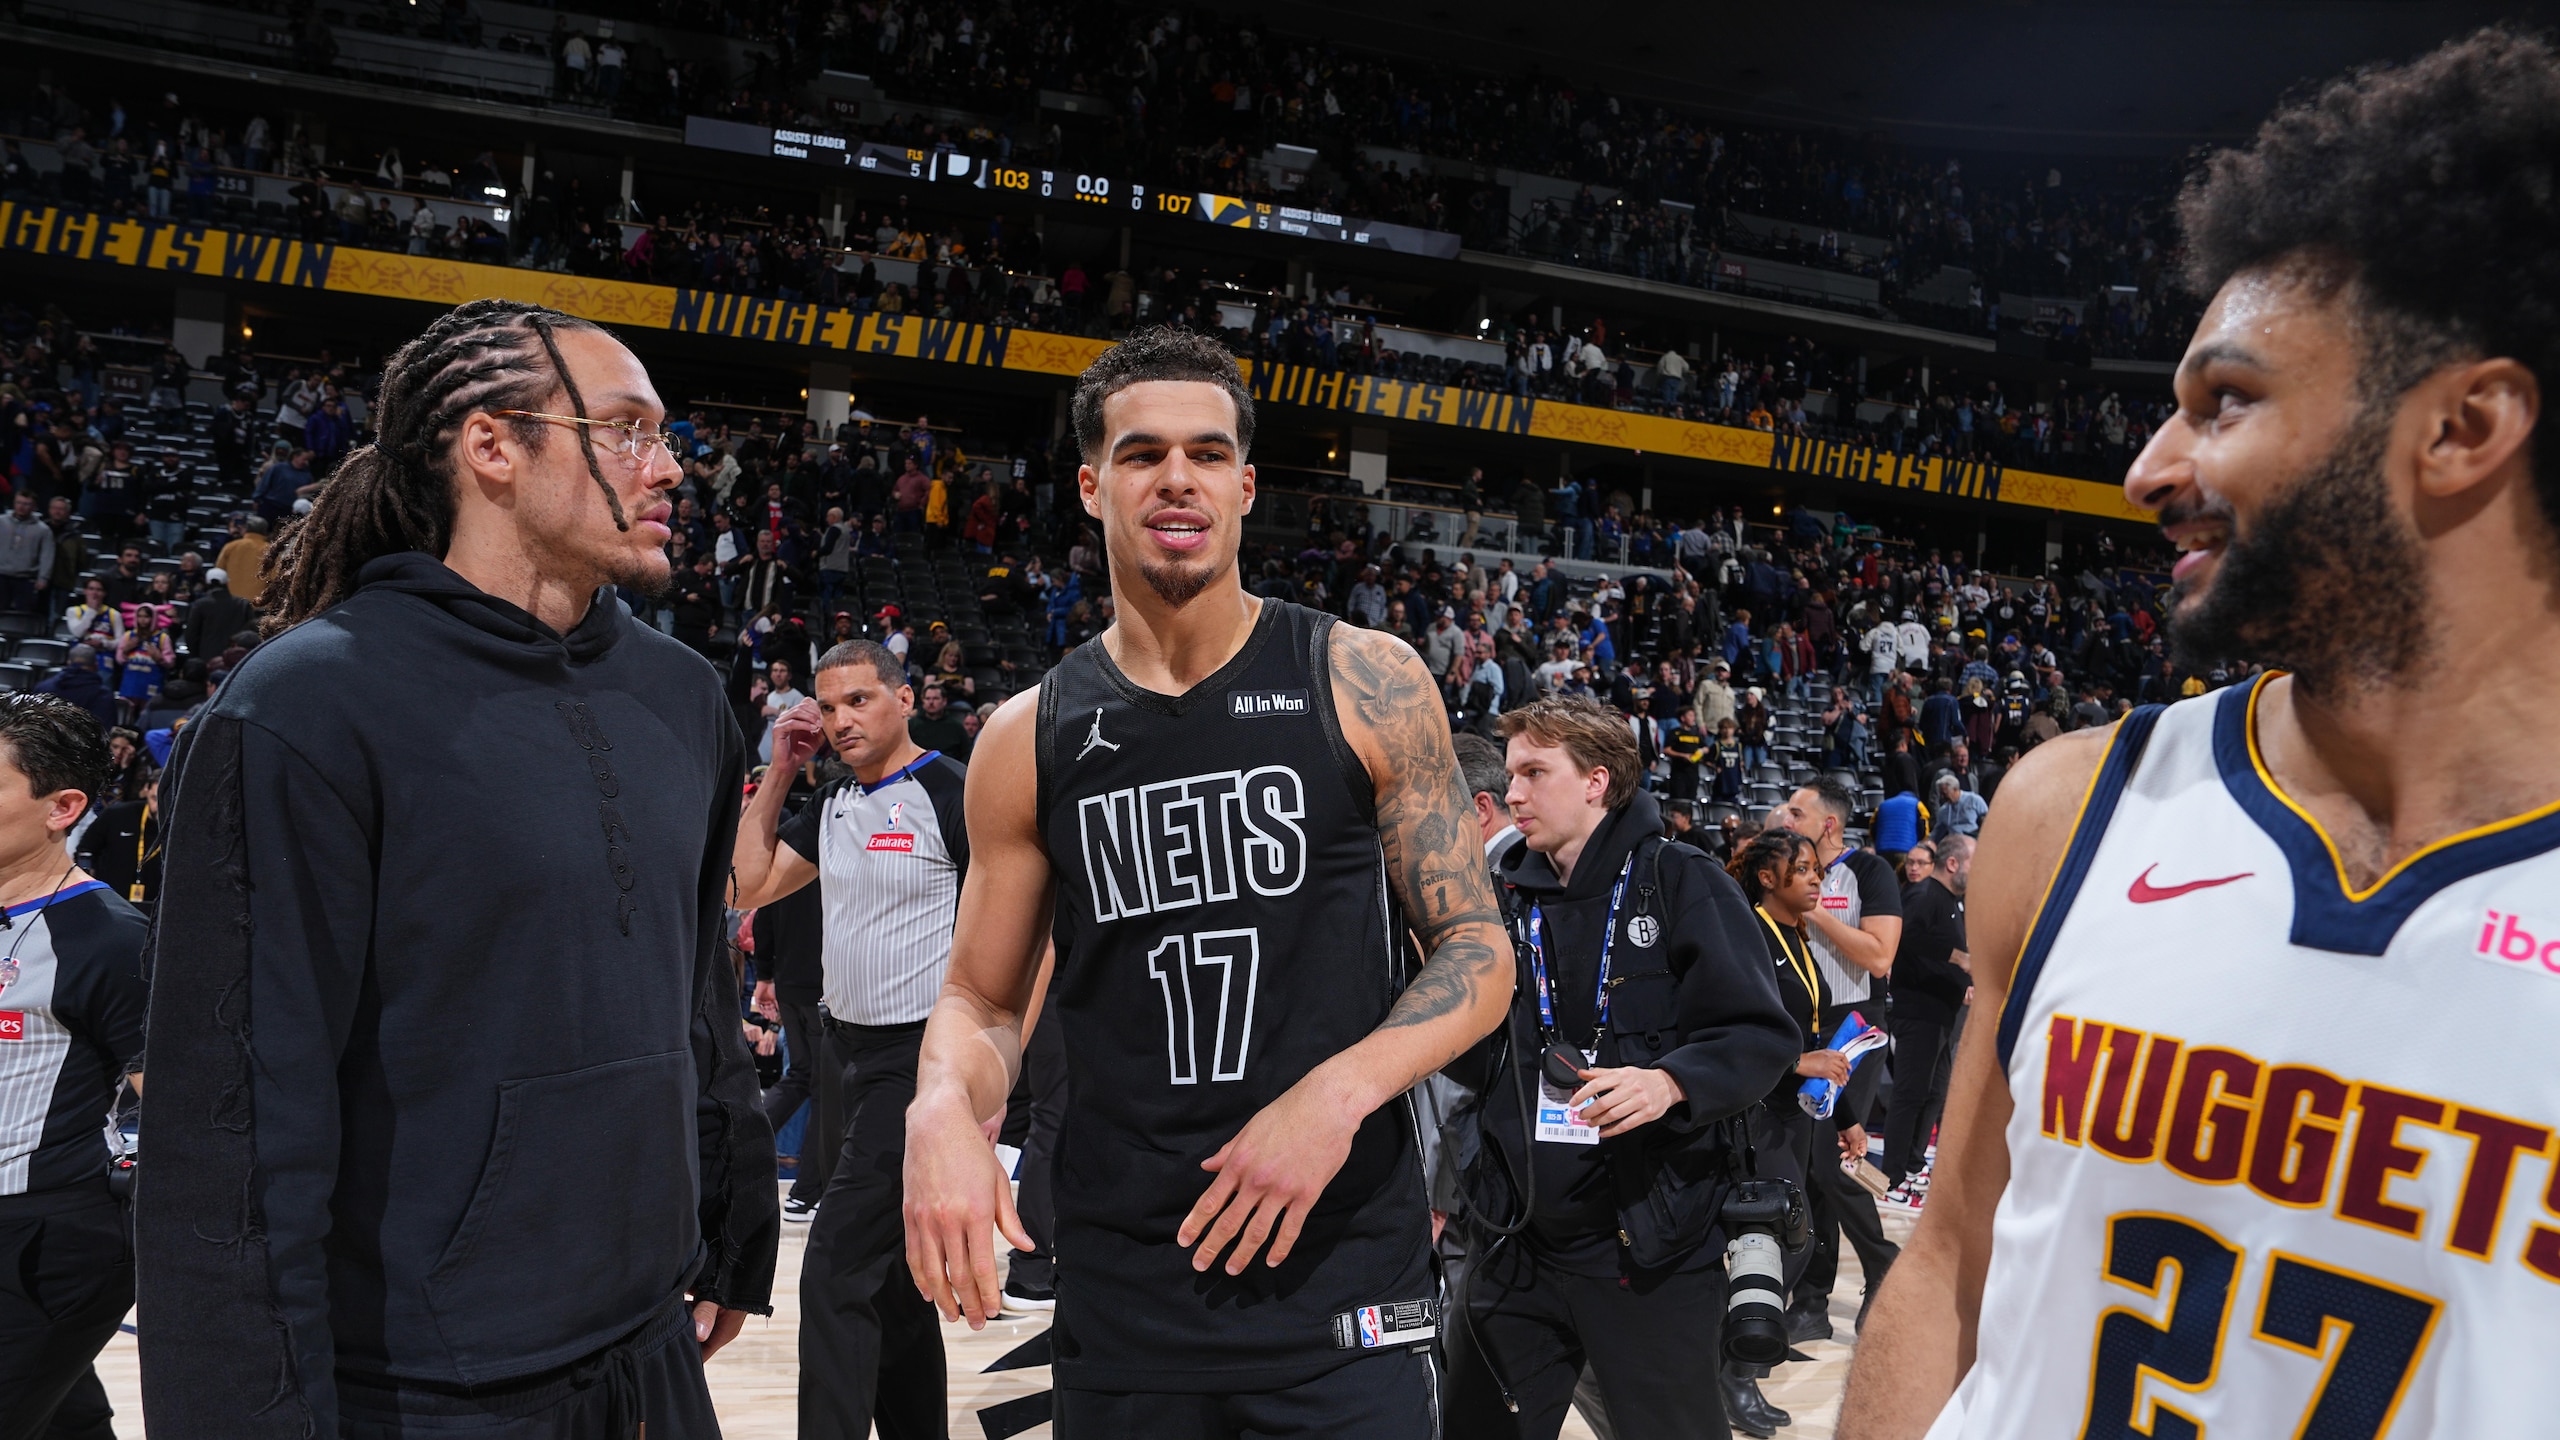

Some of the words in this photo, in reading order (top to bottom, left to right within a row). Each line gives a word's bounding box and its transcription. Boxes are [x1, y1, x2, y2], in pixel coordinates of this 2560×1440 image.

[774, 129, 811, 145] ASSISTS
[812, 136, 847, 150] LEADER
[844, 154, 851, 165] 7
[859, 157, 878, 169] AST
[906, 149, 924, 161] FLS
[910, 163, 921, 177] 5
[993, 168, 1030, 190] 103
[216, 176, 248, 193] 258
[1041, 182, 1053, 197] 0
[1076, 174, 1110, 196] 0.0
[1131, 196, 1143, 211] 0
[1157, 193, 1193, 215] 107
[1256, 202, 1272, 215] FLS
[1258, 215, 1269, 230] 5
[1312, 212, 1343, 227] LEADER
[222, 231, 334, 289] WIN
[671, 288, 903, 356] NUGGETS
[918, 317, 1011, 368] WIN
[1250, 359, 1447, 422] NUGGETS
[1457, 389, 1535, 435] WIN
[1770, 433, 1932, 490] NUGGETS
[1940, 458, 2003, 501] WIN
[1880, 641, 1893, 653] 27
[1235, 696, 1253, 713] All
[1257, 695, 1270, 712] In
[1272, 694, 1304, 711] Won
[868, 837, 913, 848] Emirates
[1078, 765, 1307, 923] NETS
[1435, 886, 1450, 916] 1
[1821, 899, 1847, 907] mirates
[1638, 920, 1651, 944] B
[1148, 927, 1260, 1084] 17
[0, 1019, 21, 1033] es
[1384, 1314, 1394, 1323] 50
[2076, 1210, 2447, 1440] 27
